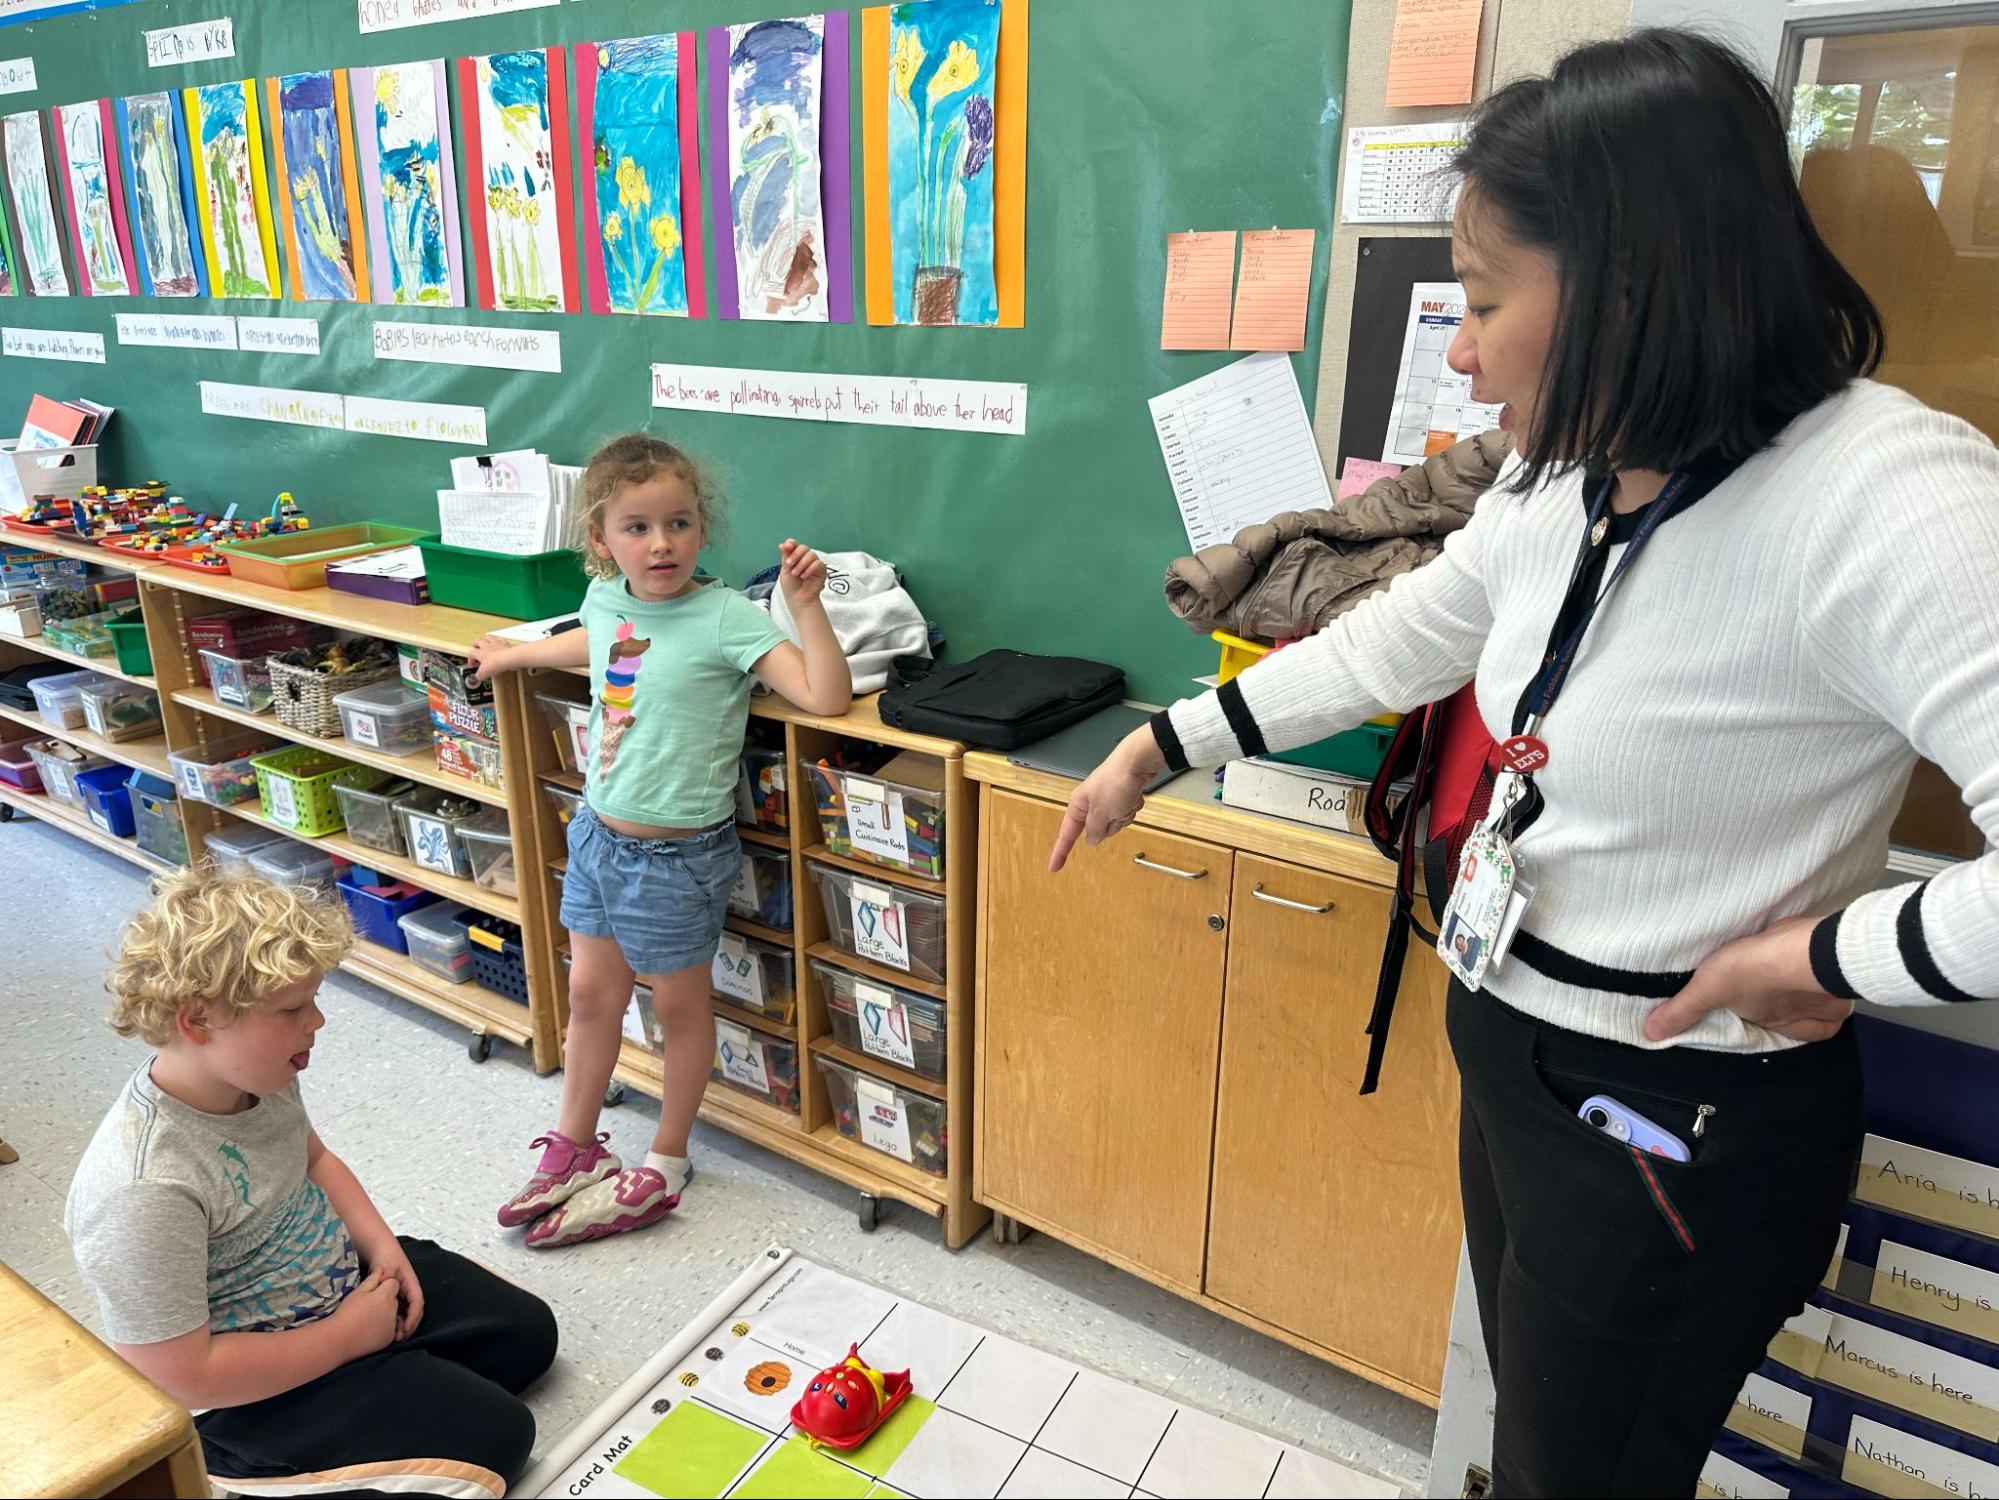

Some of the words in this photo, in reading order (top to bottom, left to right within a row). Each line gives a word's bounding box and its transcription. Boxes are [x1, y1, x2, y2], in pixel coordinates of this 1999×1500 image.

[1421, 301, 1446, 314] MAY
[1444, 302, 1465, 316] 202
[654, 374, 675, 399] The
[704, 389, 721, 403] are
[826, 386, 843, 421] put
[852, 387, 880, 415] their
[891, 389, 908, 414] tail
[913, 390, 948, 418] above
[982, 393, 1013, 424] head
[449, 711, 481, 734] PUZZLE
[452, 702, 480, 721] FLOOR
[1506, 748, 1517, 758] I
[1513, 749, 1546, 770] ECFS
[856, 929, 885, 951] Large
[863, 1028, 891, 1048] Large
[1878, 1160, 1937, 1193] Aria
[1959, 1186, 1979, 1204] is
[1891, 1266, 1960, 1312] Henry
[1976, 1295, 1991, 1311] is
[783, 1341, 806, 1356] Home
[1825, 1334, 1898, 1379] Marcus
[1909, 1371, 1923, 1386] is
[1932, 1372, 1974, 1404] here
[1747, 1394, 1783, 1424] here
[569, 1462, 605, 1497] Card
[602, 1434, 633, 1463] Mat
[1855, 1436, 1926, 1480] Nathan
[1944, 1476, 1959, 1493] is
[1714, 1482, 1727, 1498] is
